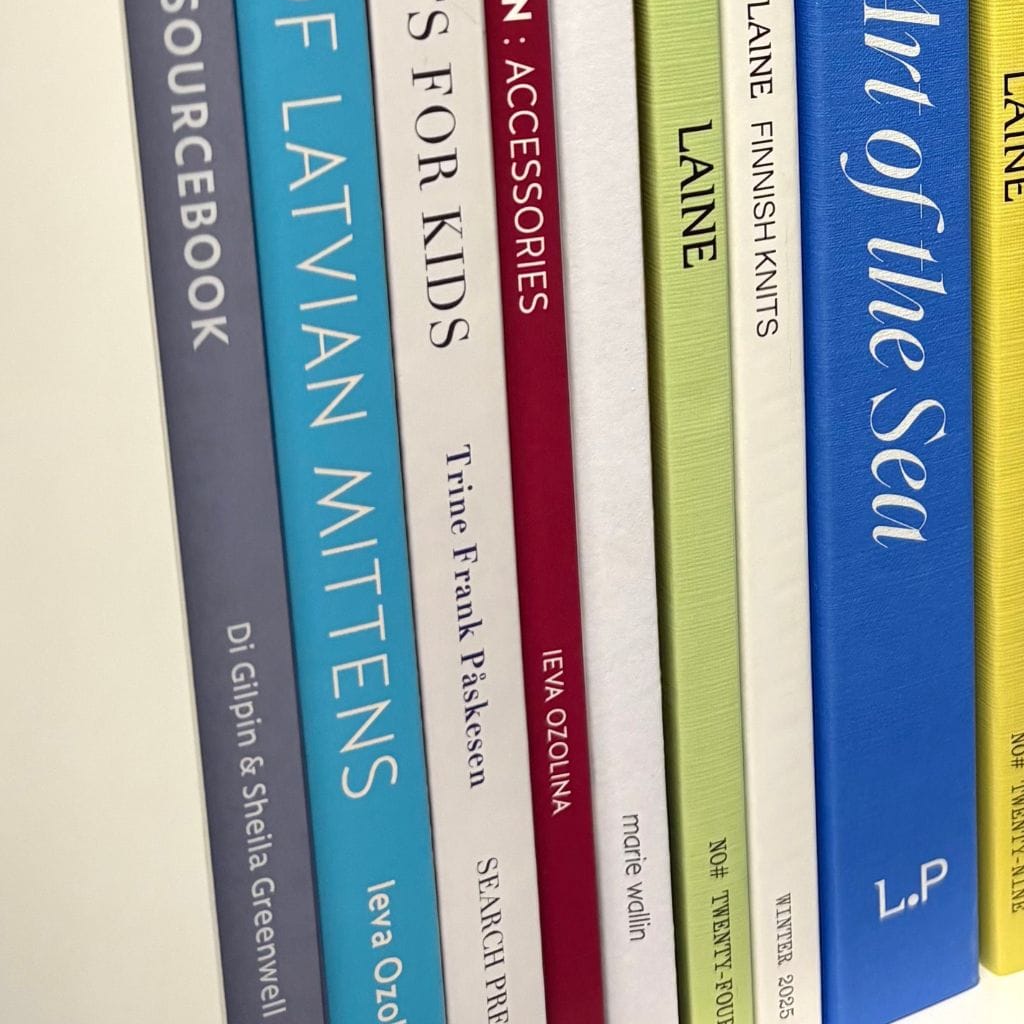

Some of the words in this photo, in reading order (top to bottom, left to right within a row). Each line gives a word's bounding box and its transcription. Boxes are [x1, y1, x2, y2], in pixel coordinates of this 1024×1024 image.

[411, 62, 460, 192] FOR
[505, 58, 549, 314] ACCESSORIES
[678, 120, 717, 269] LAINE
[751, 121, 775, 242] FINNISH
[839, 129, 944, 234] of
[281, 94, 367, 429] LATVIAN
[422, 205, 470, 350] KIDS
[755, 248, 778, 338] KNITS
[867, 237, 948, 371] the
[445, 443, 473, 536] Trine
[870, 388, 947, 549] Sea
[226, 622, 254, 654] Di
[314, 466, 398, 800] MITTENS
[452, 542, 484, 642] Frank
[228, 663, 262, 748] Gilpin
[460, 647, 488, 790] Påskesen
[541, 648, 564, 705] IEVA
[239, 756, 264, 776] &
[545, 708, 572, 816] OZOLINA
[240, 781, 270, 871] Sheila
[622, 813, 642, 876] marie
[709, 837, 728, 879] NO#
[248, 879, 287, 1017] Greenwell
[367, 879, 396, 949] Ieva
[476, 856, 506, 972] SEARCH
[626, 880, 647, 942] wallin
[776, 893, 793, 966] WINTER
[778, 974, 794, 1019] 2025
